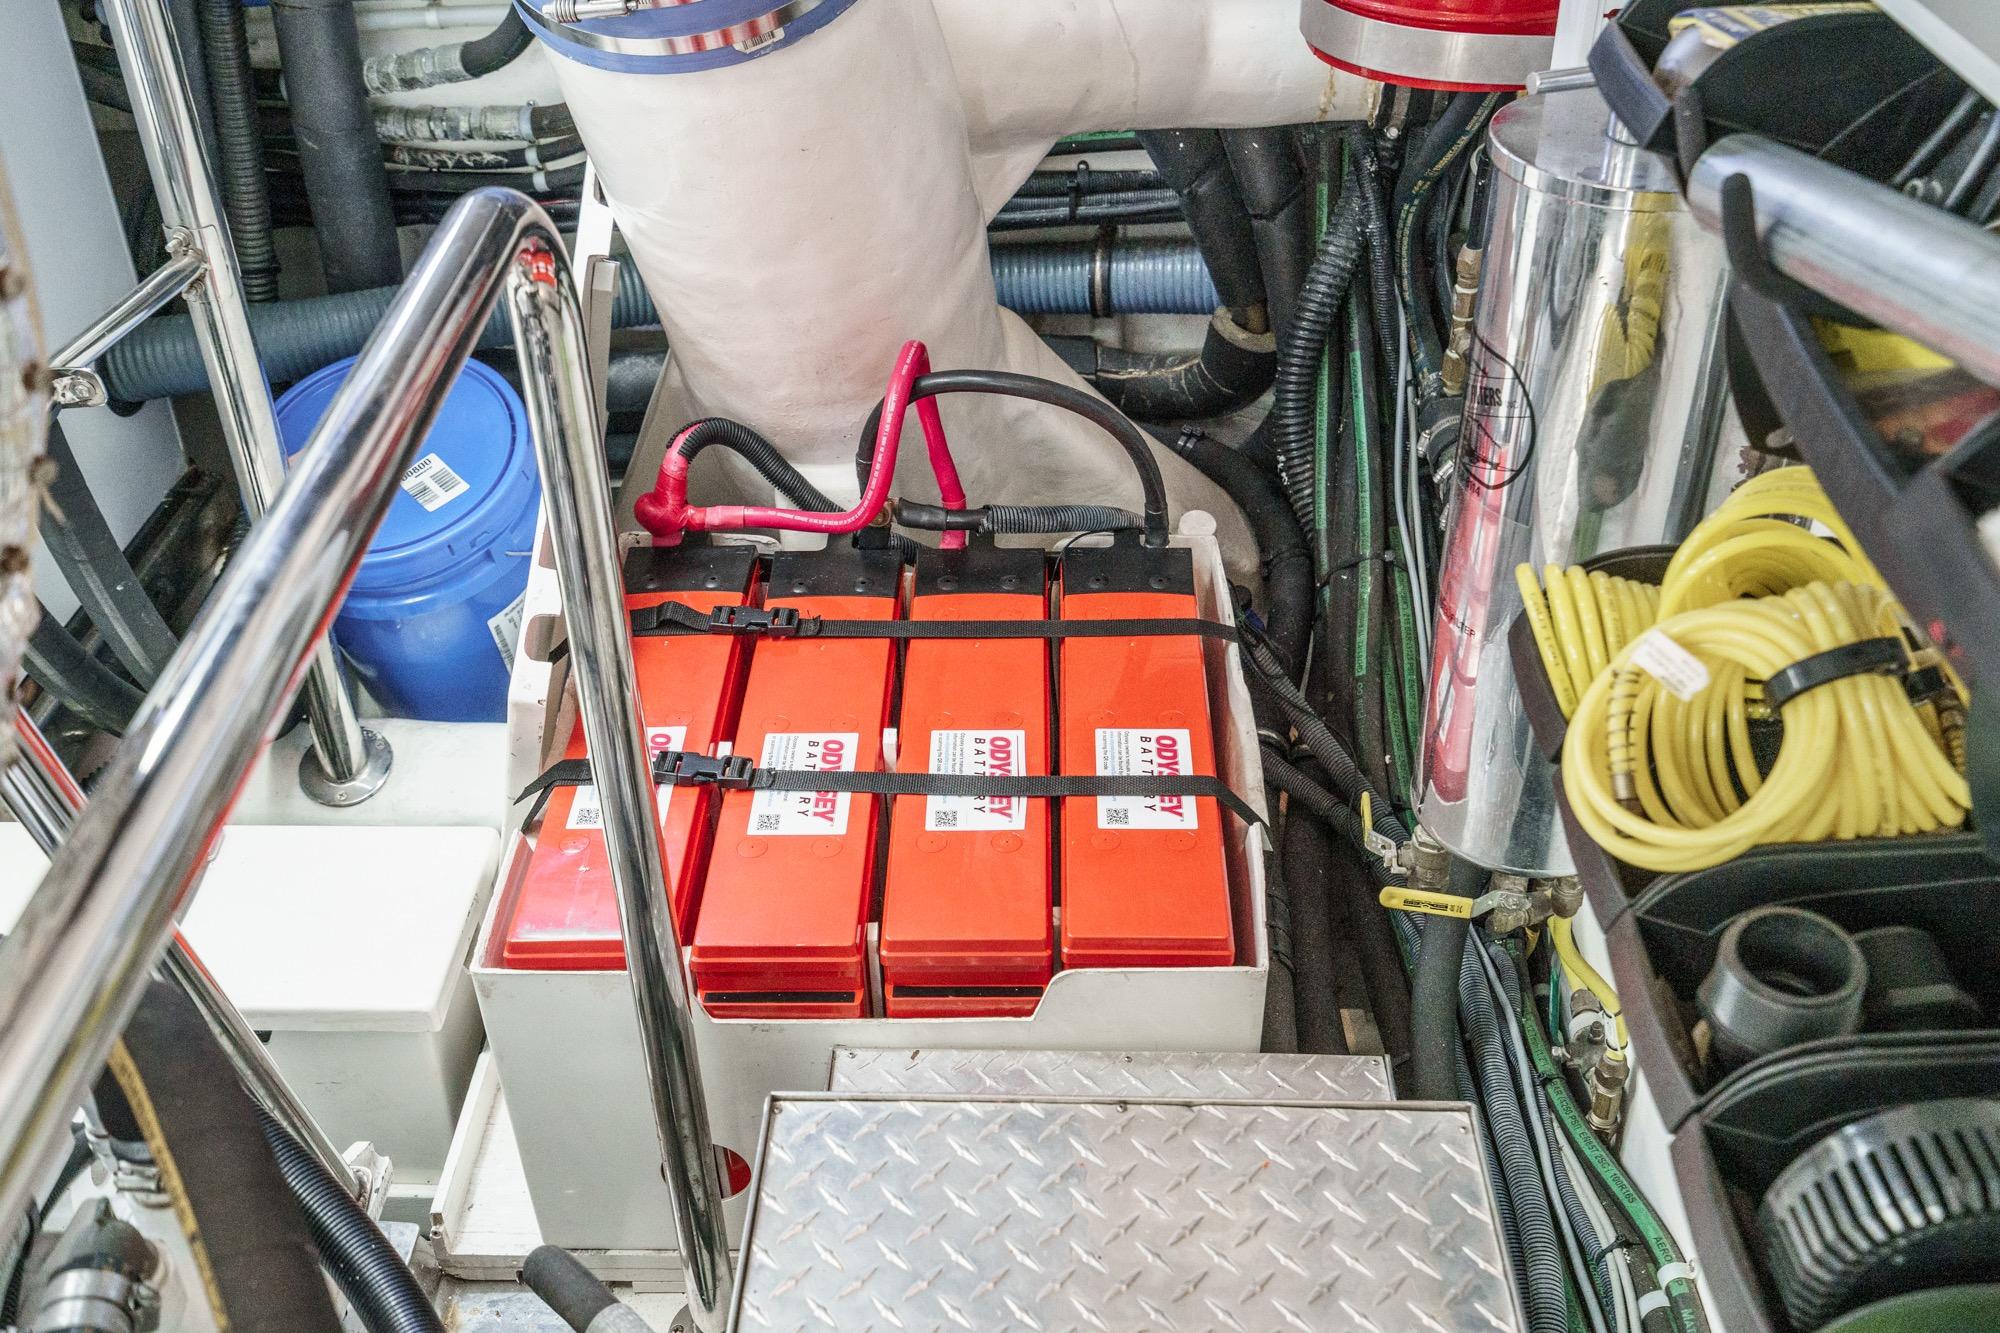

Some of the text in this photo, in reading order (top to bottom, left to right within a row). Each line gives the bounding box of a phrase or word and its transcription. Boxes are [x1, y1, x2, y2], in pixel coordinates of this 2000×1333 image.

[797, 740, 819, 817] BATRY
[813, 739, 845, 824] ODSEY
[974, 737, 986, 813] BATTRY
[989, 736, 1012, 819] ODYEY
[1140, 736, 1157, 812] BATTRY
[1156, 735, 1184, 817] ODYEY
[1653, 1237, 1684, 1286] AEROP
